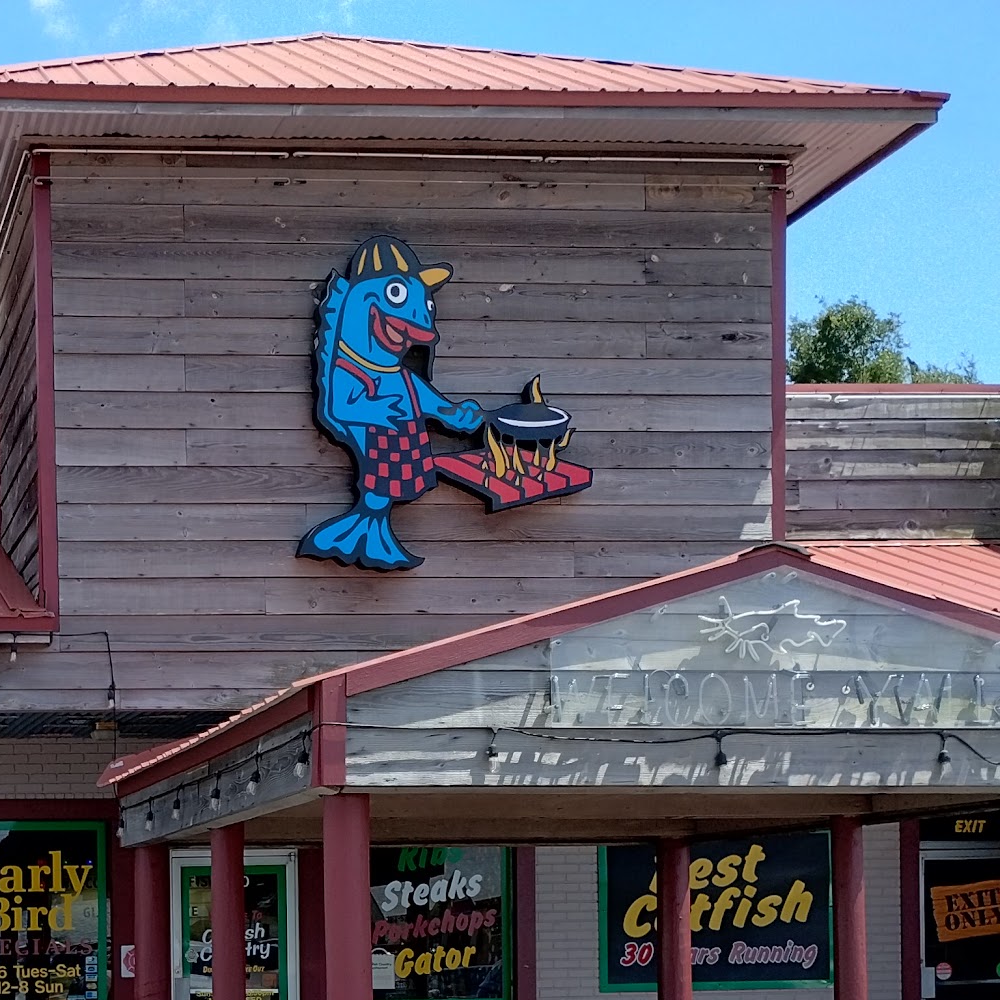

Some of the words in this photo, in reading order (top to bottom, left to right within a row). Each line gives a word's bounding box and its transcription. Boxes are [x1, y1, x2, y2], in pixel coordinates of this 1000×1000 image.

[955, 820, 986, 833] EXIT
[649, 844, 766, 893] est
[381, 870, 482, 912] Steaks
[945, 888, 1000, 912] EXIT
[623, 880, 813, 938] Ctfish
[372, 909, 497, 945] Porkchops
[200, 942, 271, 960] Ctry
[395, 946, 476, 978] Gator
[620, 942, 654, 966] 30
[690, 947, 721, 965] ars
[728, 940, 818, 969] Running
[13, 964, 81, 979] Tues-Sat
[35, 980, 64, 994] Sun
